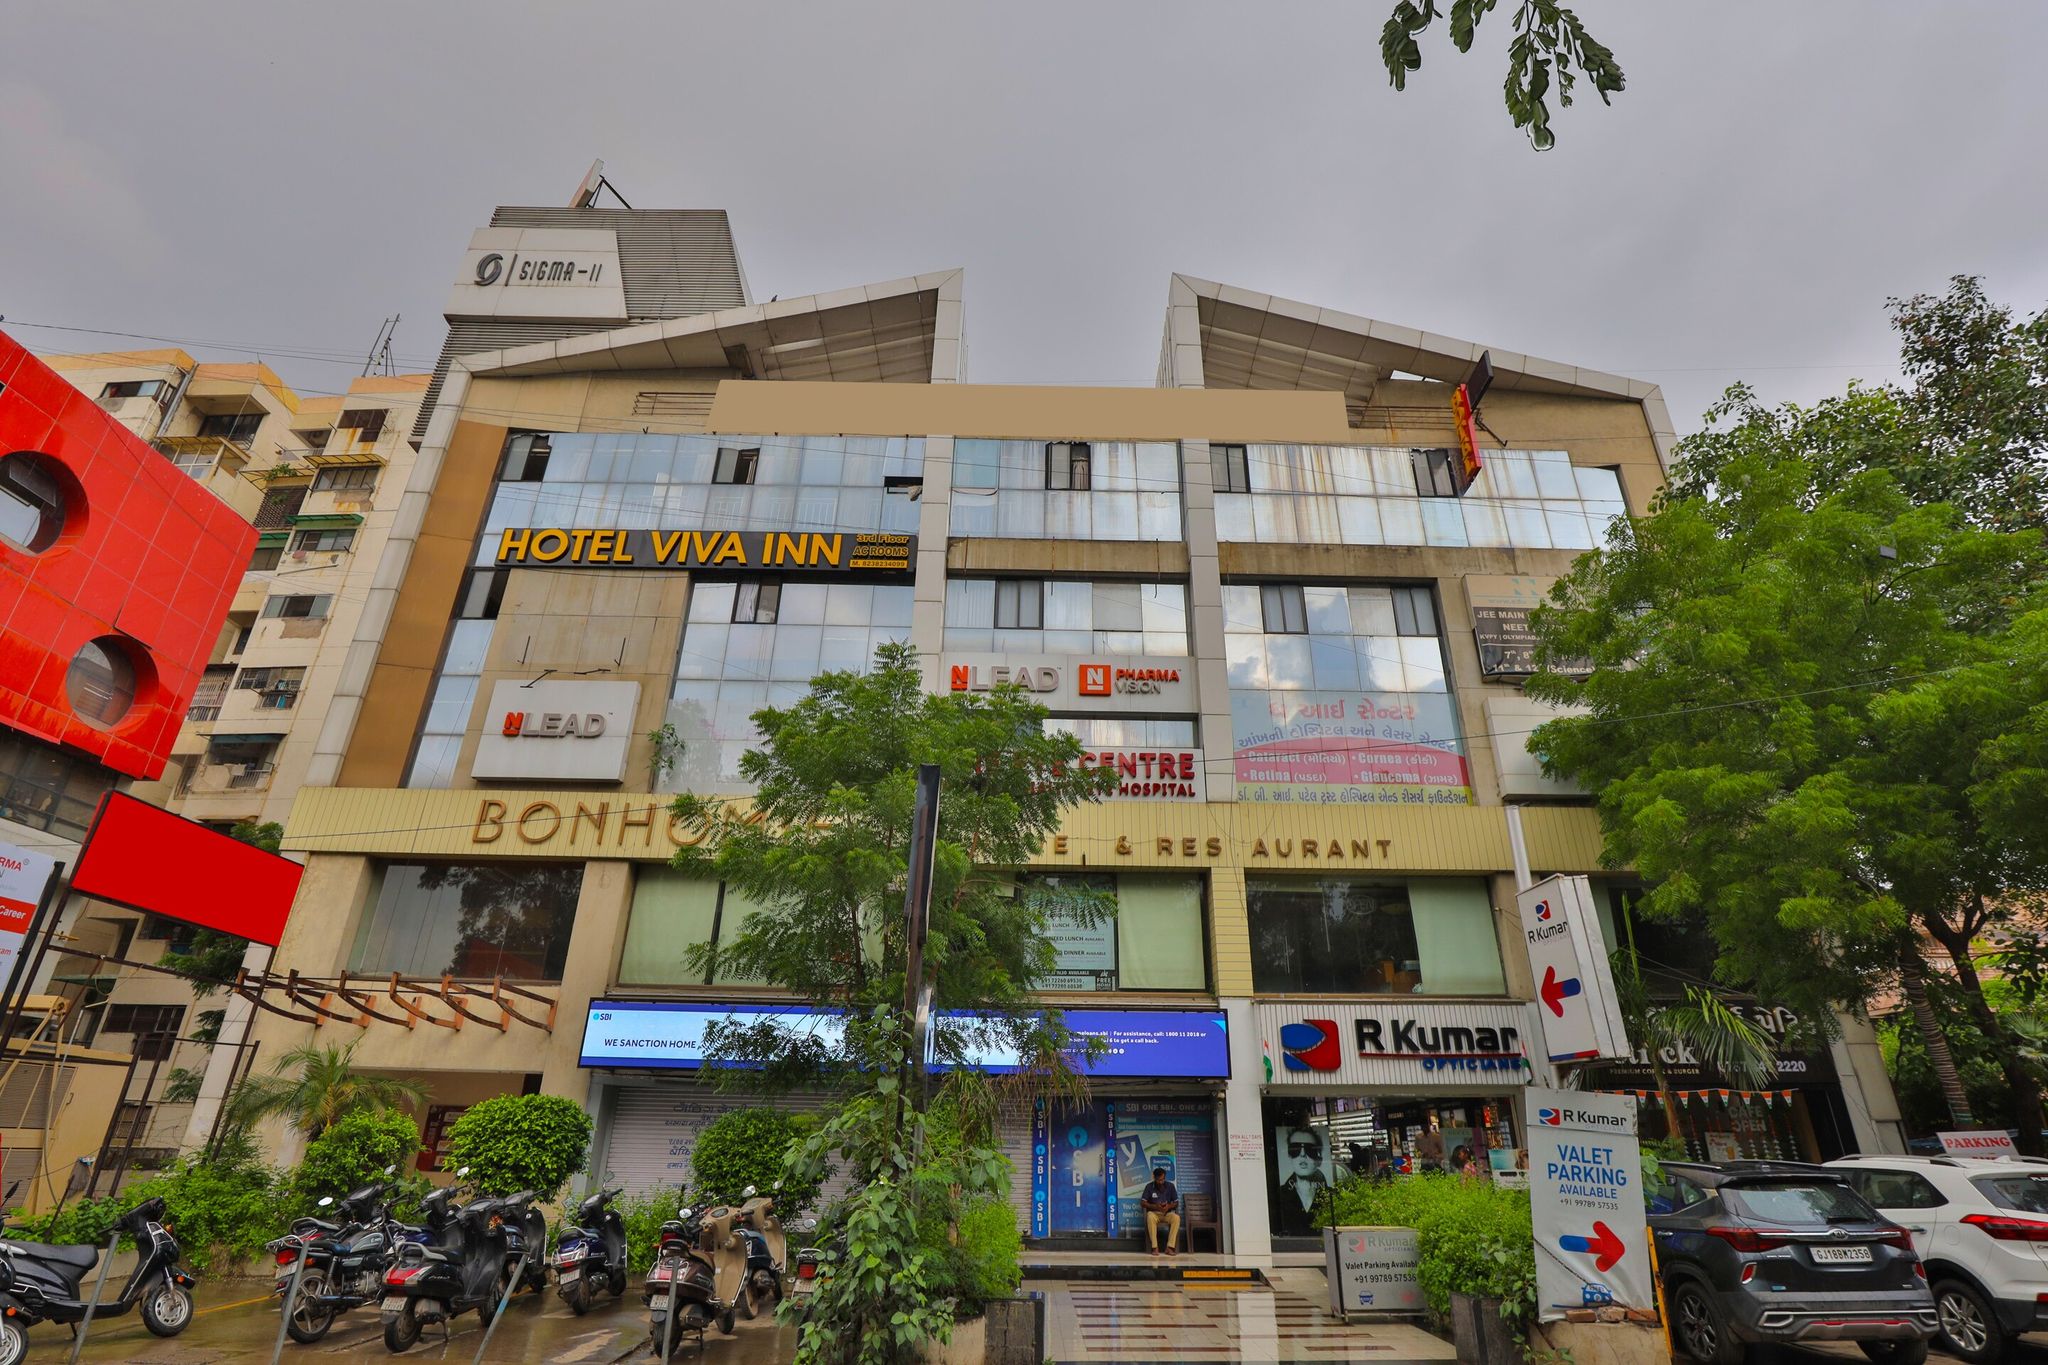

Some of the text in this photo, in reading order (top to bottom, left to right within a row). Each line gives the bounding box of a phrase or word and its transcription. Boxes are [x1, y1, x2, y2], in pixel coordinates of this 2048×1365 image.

[857, 534, 909, 544] 3rd Floor
[498, 528, 843, 568] HOTEL VIVA INN
[853, 546, 909, 557] AC ROOMS
[1498, 611, 1525, 619] MAIN
[1503, 623, 1528, 632] NEET
[1116, 669, 1180, 682] PHARMA
[1115, 682, 1161, 694] VISION
[1248, 751, 1300, 763] Cataract
[1358, 752, 1402, 764] Cornea
[1249, 769, 1291, 782] Retina
[1360, 770, 1420, 784] Glaucoma
[1119, 782, 1196, 797] HOSPITAL
[1116, 835, 1133, 855] &
[1527, 930, 1537, 944] R
[1536, 921, 1569, 941] Kumar
[600, 1013, 612, 1021] SBI
[1354, 1018, 1518, 1053] R Kumar
[604, 1038, 696, 1049] WE SANCTION HOME
[1422, 1057, 1521, 1072] OPTICIANS
[1776, 1061, 1807, 1072] 2220
[1125, 1103, 1139, 1112] SBI
[1563, 1109, 1627, 1126] R Kumar
[1944, 1135, 2011, 1149] PARKING
[1557, 1145, 1613, 1166] VALET
[1547, 1163, 1627, 1186] PARKING
[1559, 1184, 1618, 1199] AVAILABLE
[1574, 1200, 1596, 1208] 99789
[1597, 1201, 1619, 1210] 57535
[1367, 1236, 1415, 1247] R Kumar
[1345, 1262, 1363, 1270] Valet
[1364, 1261, 1390, 1270] Parking
[1354, 1275, 1368, 1283] +91
[1369, 1274, 1393, 1283] 99789
